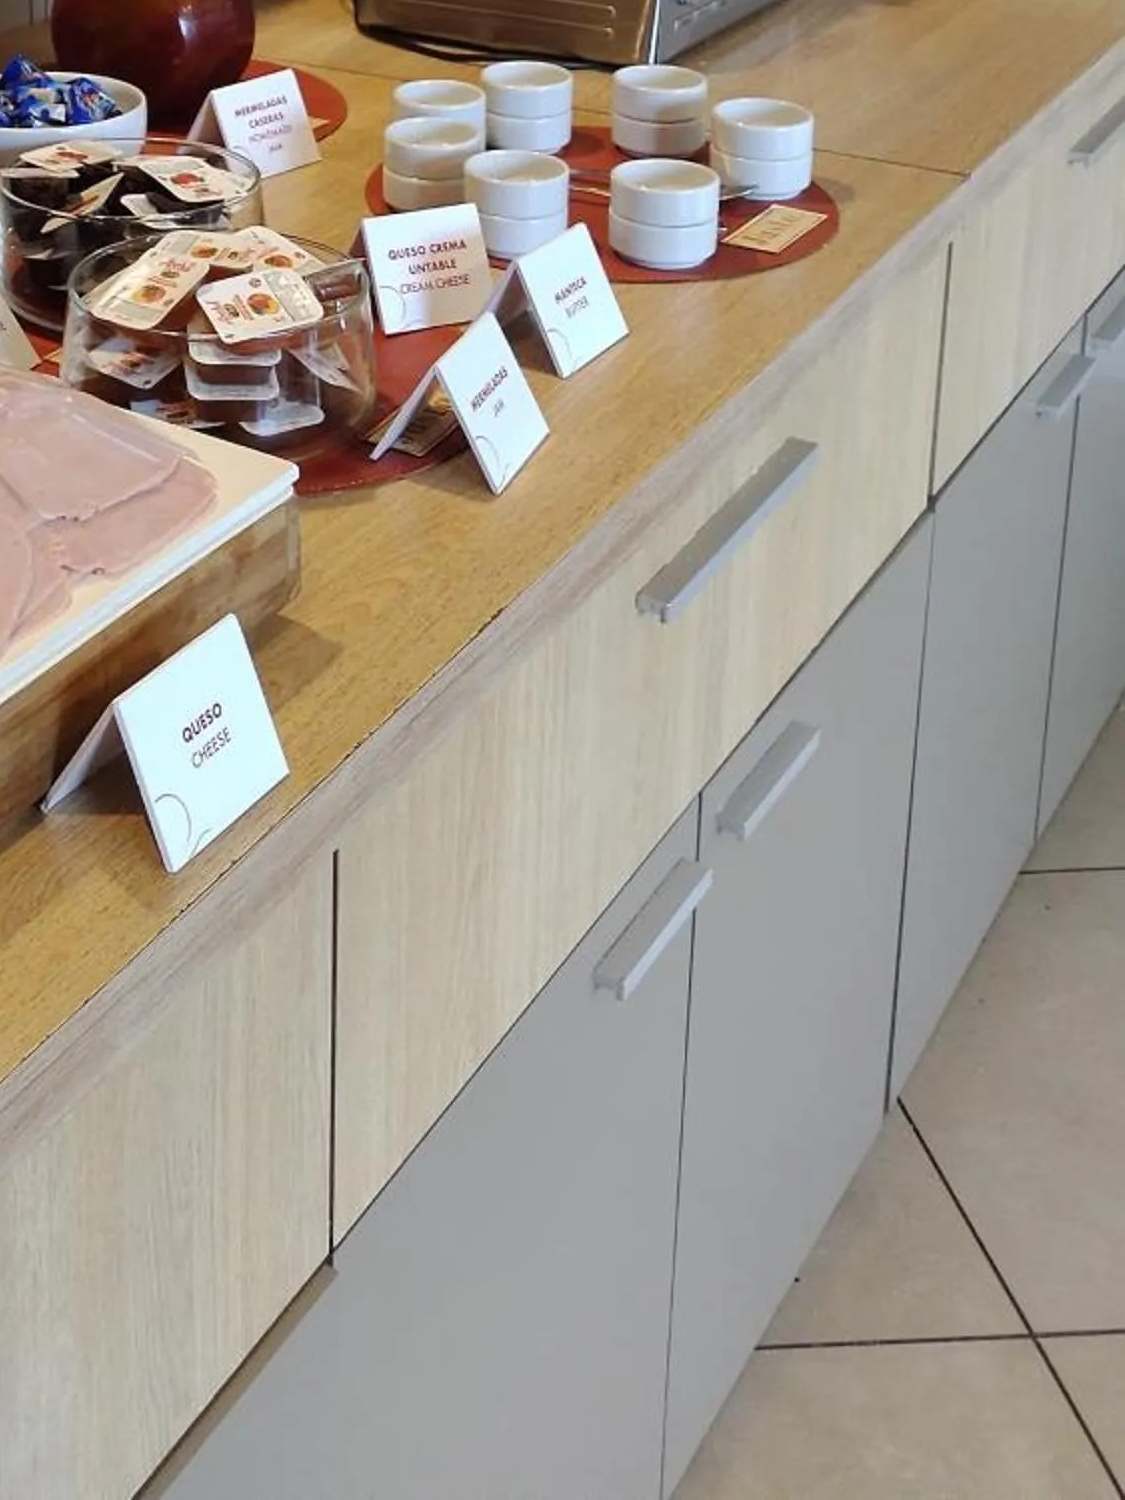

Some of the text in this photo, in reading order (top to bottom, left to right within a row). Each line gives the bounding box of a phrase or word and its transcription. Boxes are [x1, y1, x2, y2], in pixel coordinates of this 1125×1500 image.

[387, 238, 468, 261] QUESO CREMA
[408, 258, 457, 275] UNTABLE
[400, 273, 471, 294] CREAM CHEESE
[181, 702, 222, 744] QUESO
[191, 726, 232, 769] CHEESE
